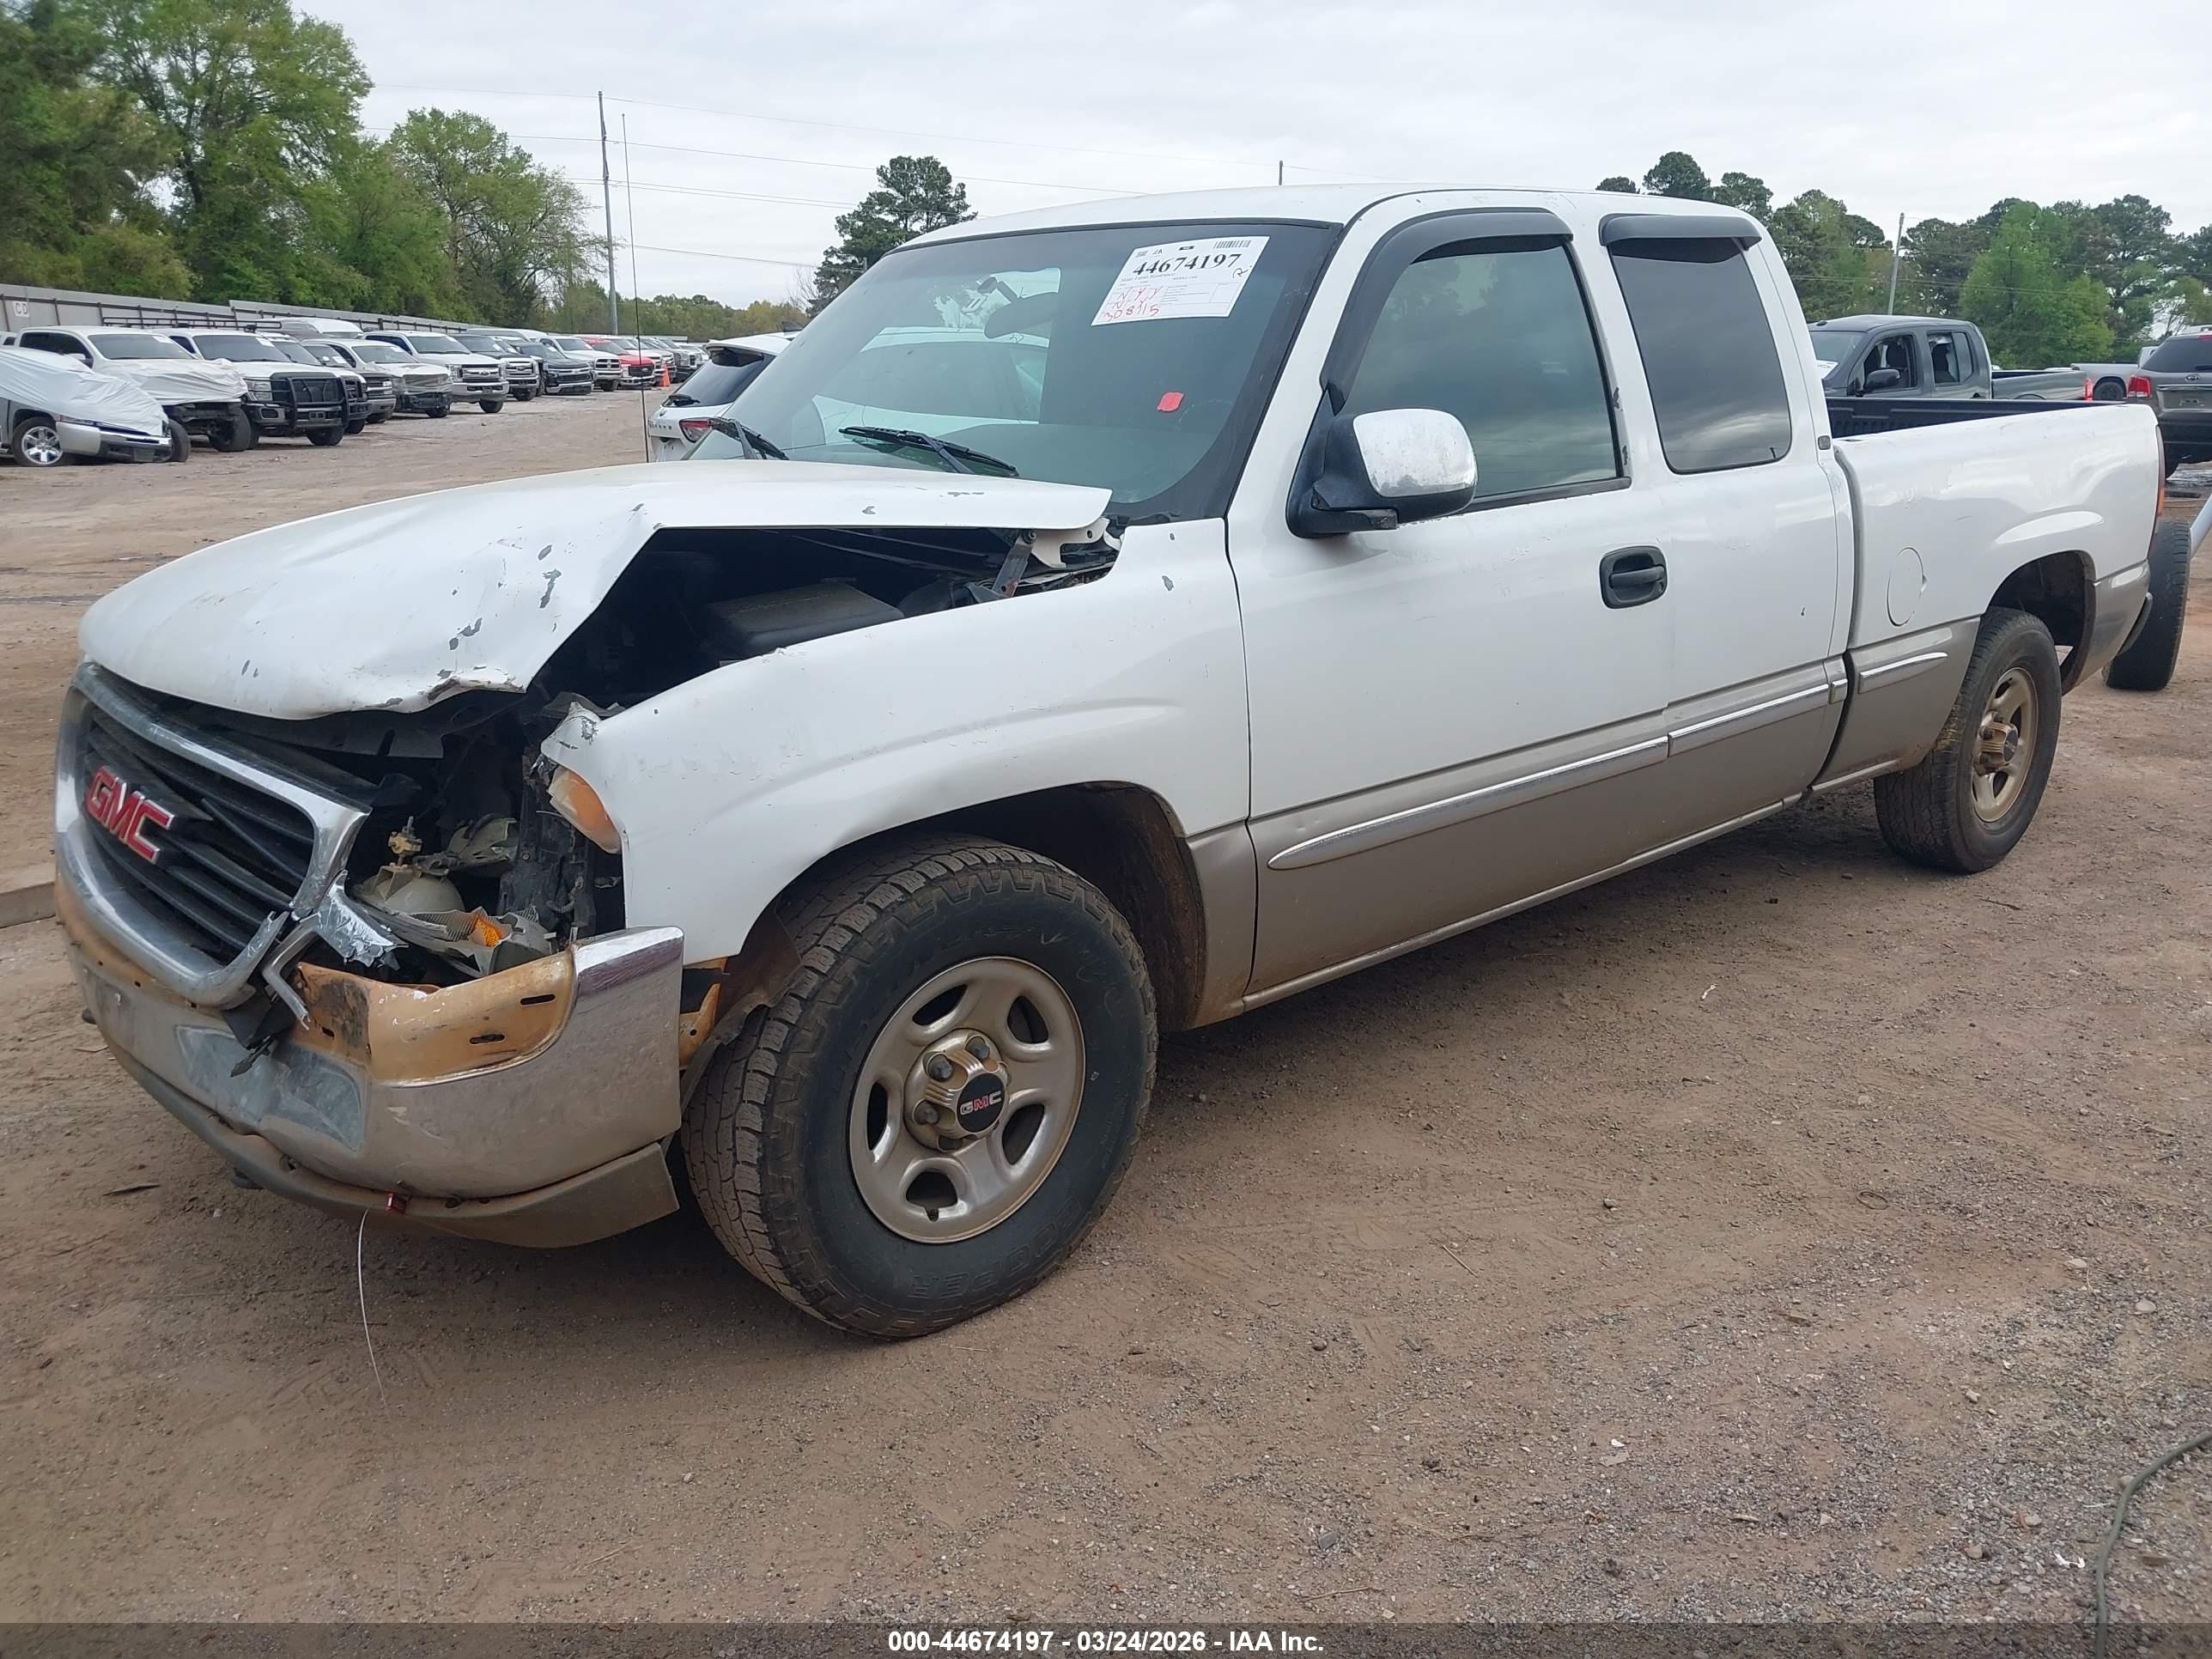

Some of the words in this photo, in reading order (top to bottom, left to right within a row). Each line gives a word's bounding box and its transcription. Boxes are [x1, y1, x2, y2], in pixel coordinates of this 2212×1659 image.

[1133, 253, 1243, 276] 44674197
[84, 765, 176, 865] GMC
[960, 1091, 1002, 1115] GMC
